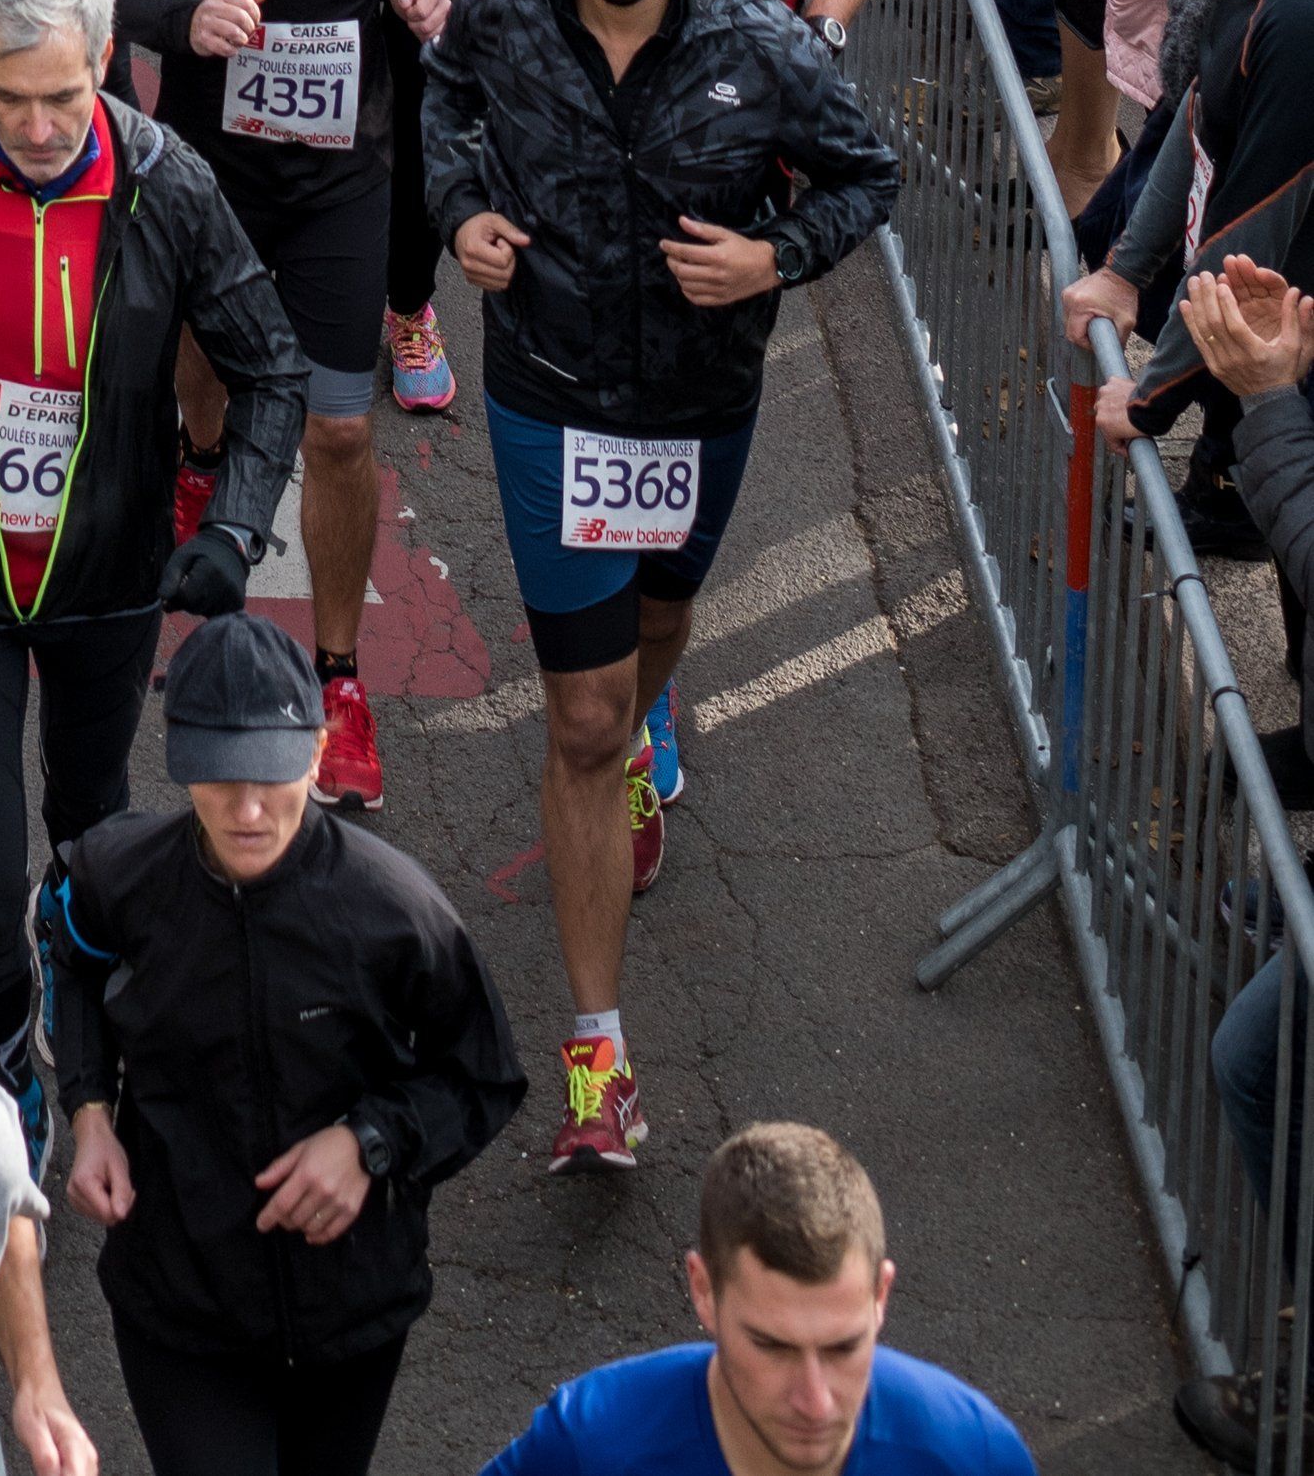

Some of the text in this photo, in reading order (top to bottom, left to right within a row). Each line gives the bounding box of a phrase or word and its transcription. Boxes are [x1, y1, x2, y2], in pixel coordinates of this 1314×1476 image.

[290, 25, 339, 38] CAISSE
[272, 41, 356, 53] D'EPARGNE
[299, 60, 352, 75] BEAUNOISES
[237, 74, 344, 121] 4351
[295, 132, 351, 146] balance
[598, 439, 694, 456] FOULÉES BEAUNOISES
[570, 457, 693, 511] 5368
[0, 511, 33, 528] new
[606, 527, 634, 543] new
